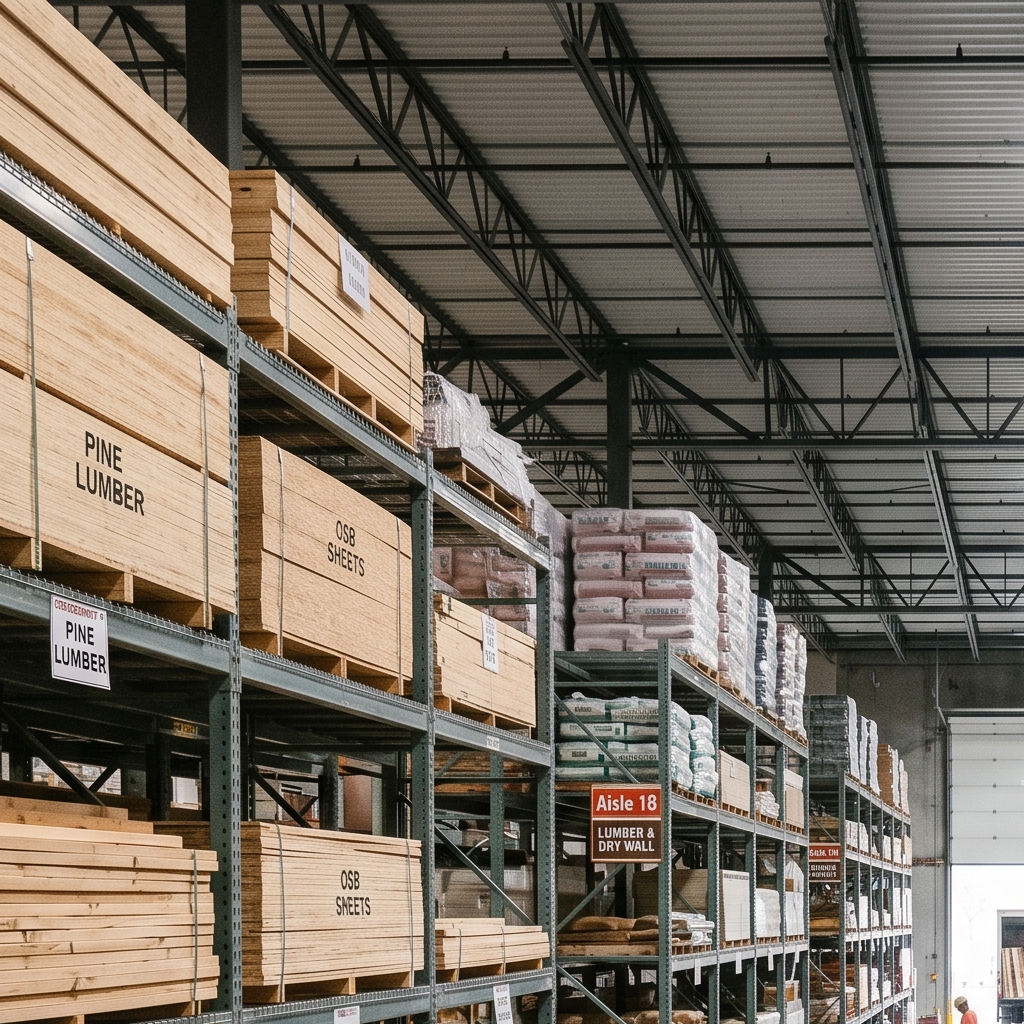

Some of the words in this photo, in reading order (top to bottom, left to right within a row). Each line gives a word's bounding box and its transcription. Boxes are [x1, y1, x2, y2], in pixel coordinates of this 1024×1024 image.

[85, 431, 122, 473] PINE
[76, 461, 145, 516] LUMBER
[336, 520, 356, 547] OSB
[327, 541, 365, 577] SHEETS
[66, 620, 95, 646] PINE
[54, 644, 107, 674] LUMBER
[595, 794, 634, 812] Aisle
[639, 794, 658, 812] 18
[598, 827, 644, 839] LUMBER
[646, 827, 655, 839] &
[598, 840, 621, 852] DRY
[623, 840, 655, 852] WALL
[341, 870, 360, 890] OSB
